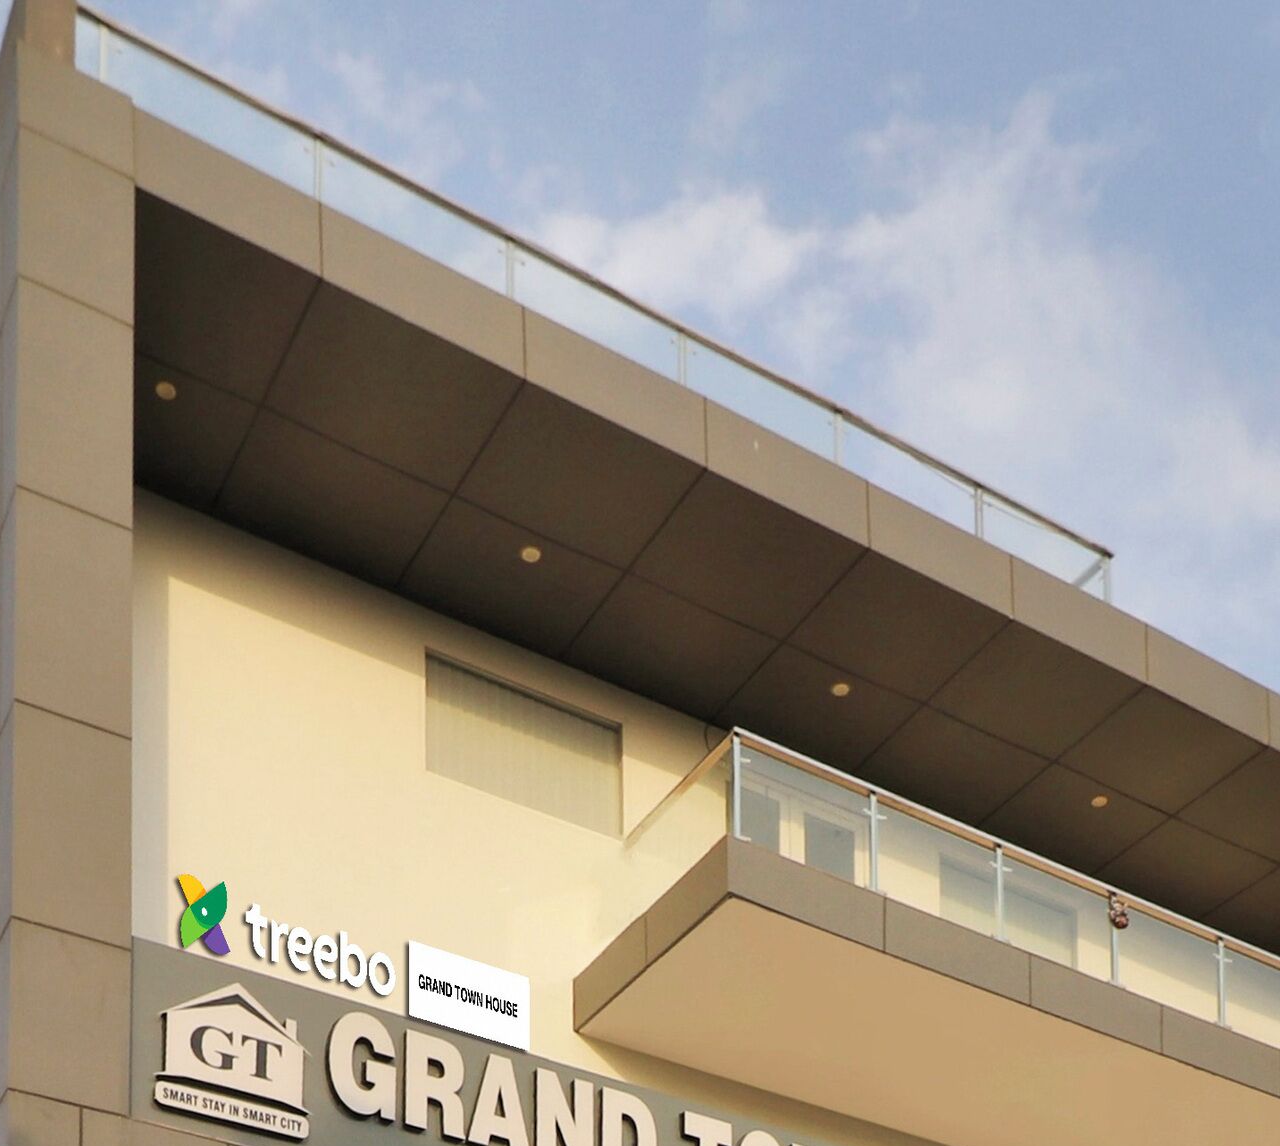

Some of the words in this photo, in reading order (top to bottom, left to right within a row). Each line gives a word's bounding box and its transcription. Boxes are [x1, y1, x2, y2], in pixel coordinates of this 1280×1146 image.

[245, 903, 396, 996] treebo
[418, 974, 452, 997] GRAND
[454, 985, 483, 1007] TOWN
[485, 994, 518, 1018] HOUSE
[190, 1025, 282, 1082] GT
[163, 1088, 198, 1107] SMART
[202, 1097, 226, 1113] STAY
[229, 1104, 239, 1116] IN
[243, 1108, 277, 1127] SMART
[280, 1117, 302, 1132] CITY
